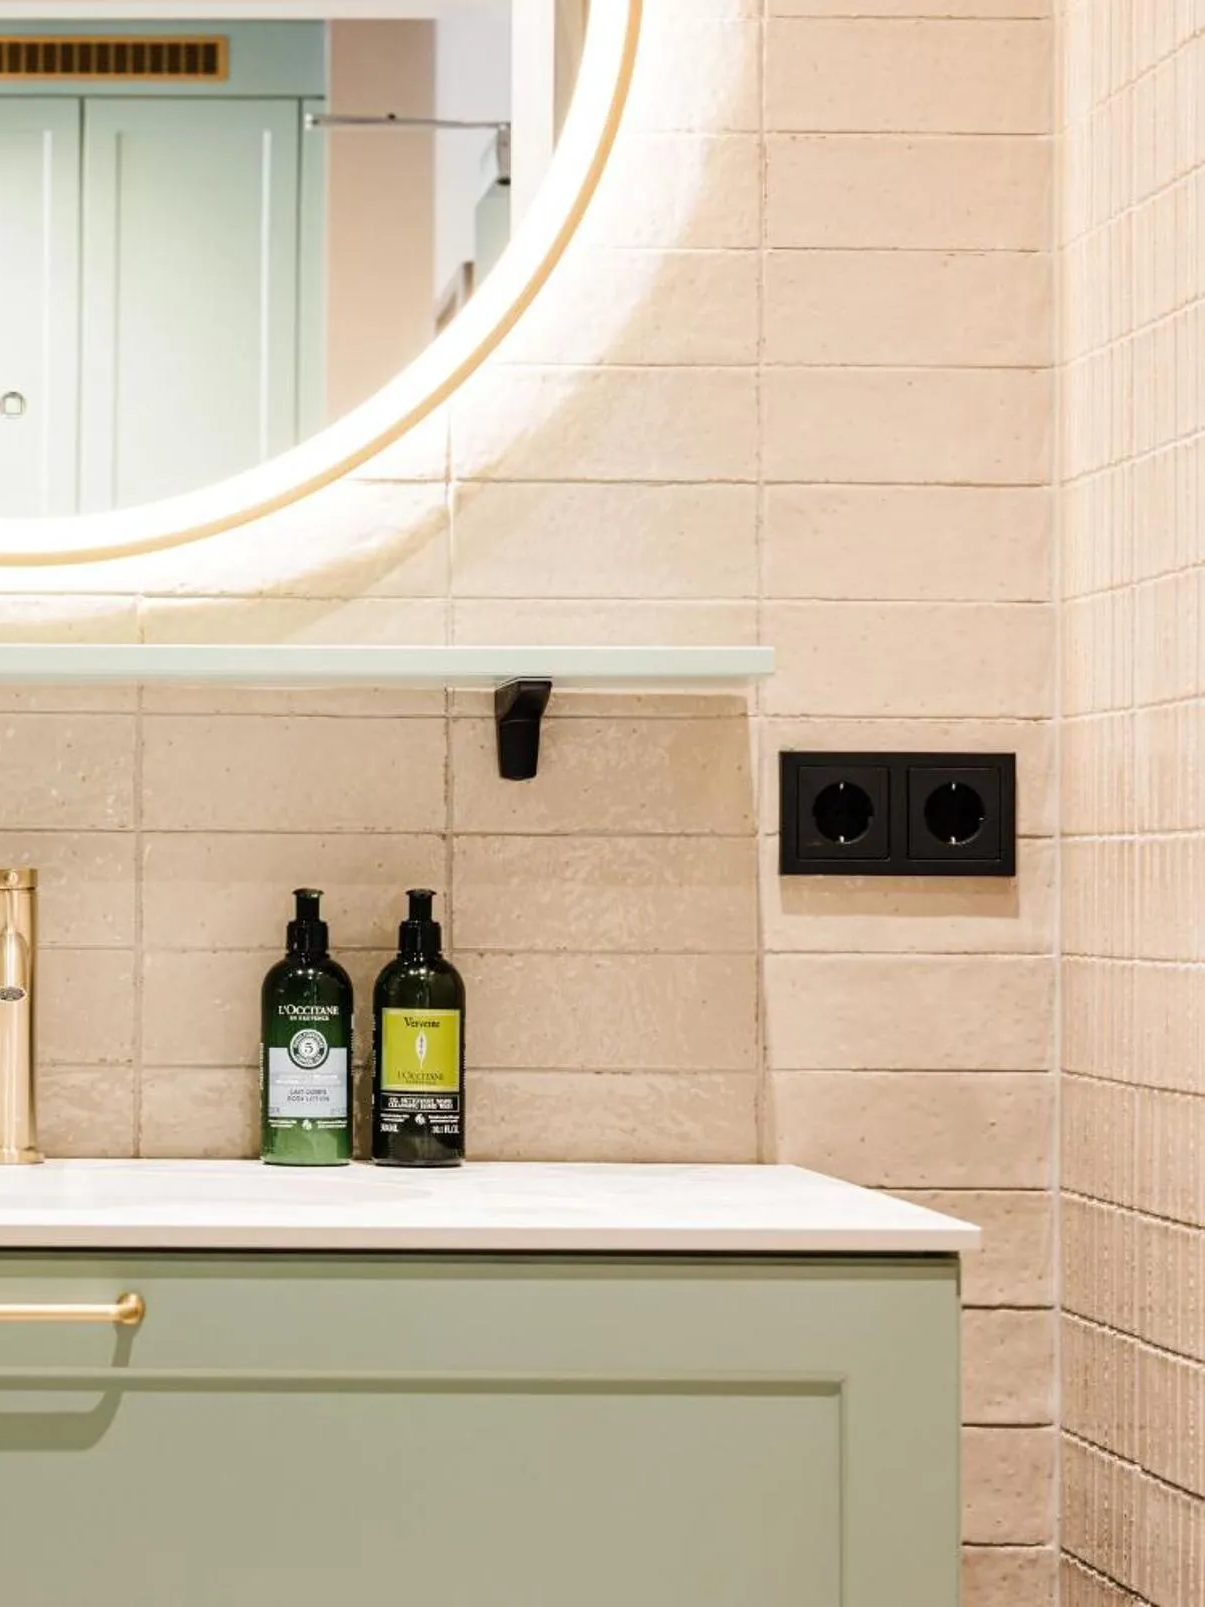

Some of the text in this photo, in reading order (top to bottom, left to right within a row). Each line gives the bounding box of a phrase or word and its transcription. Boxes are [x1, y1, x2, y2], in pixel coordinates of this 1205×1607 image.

[278, 1004, 339, 1016] L'OCCITANE
[404, 1016, 441, 1028] Verveine
[304, 1042, 314, 1054] 5
